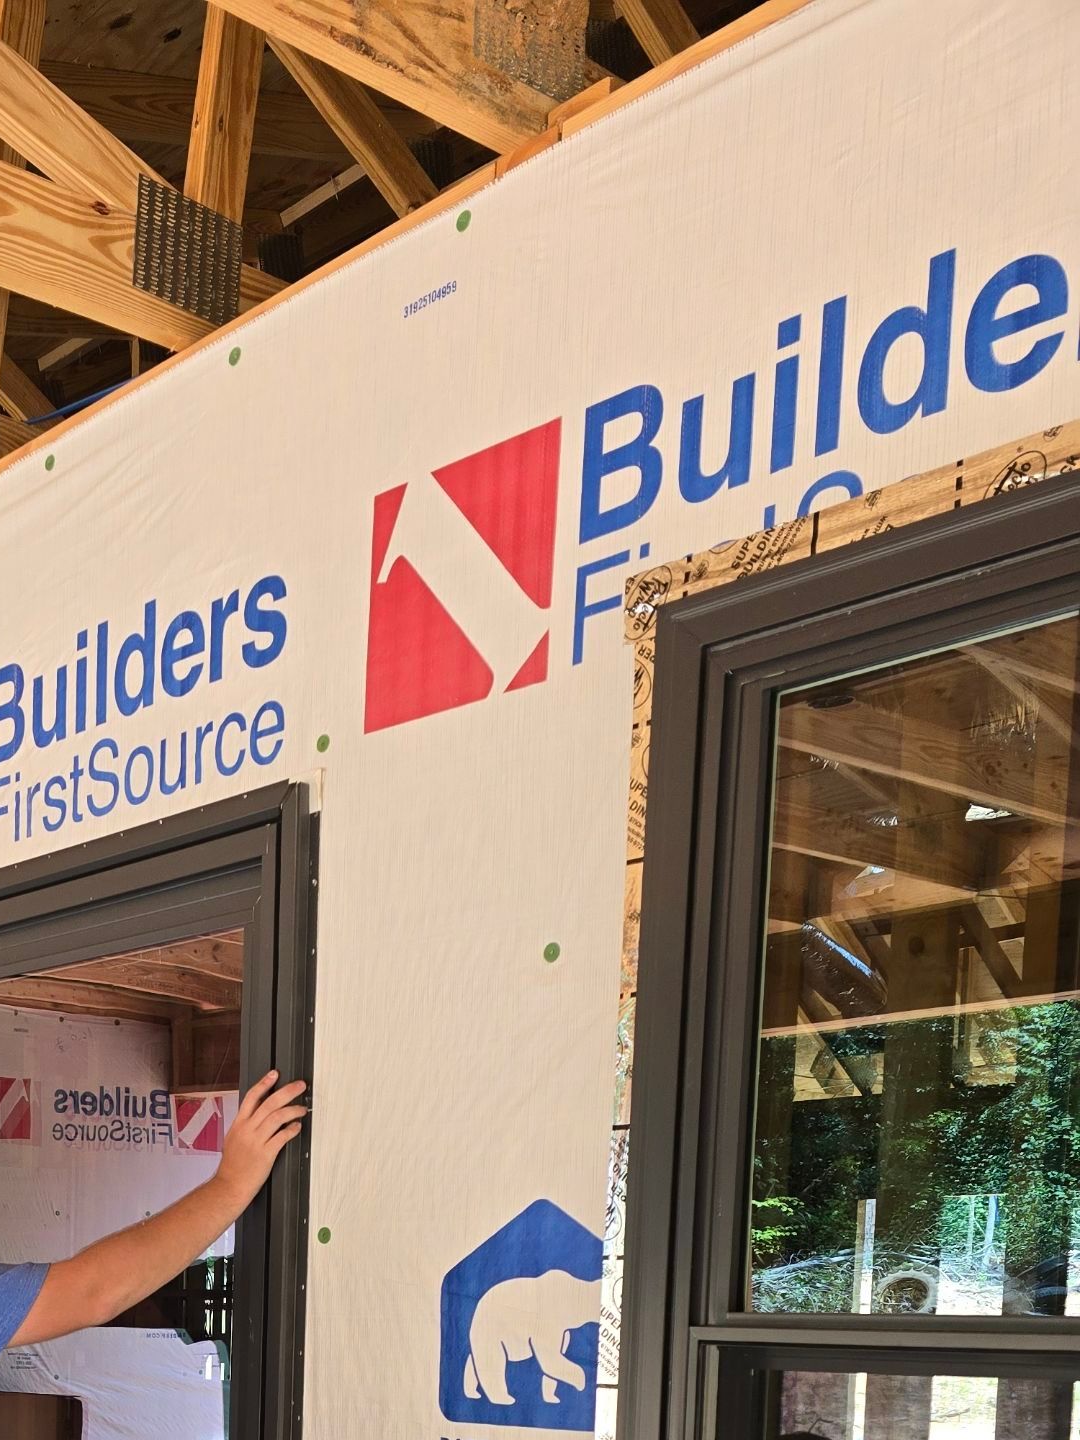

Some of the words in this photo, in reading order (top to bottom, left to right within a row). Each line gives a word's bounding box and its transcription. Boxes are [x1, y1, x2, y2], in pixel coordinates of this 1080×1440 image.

[403, 280, 457, 318] 31925104959
[578, 248, 1080, 546] Builde
[731, 532, 760, 570] SUPE
